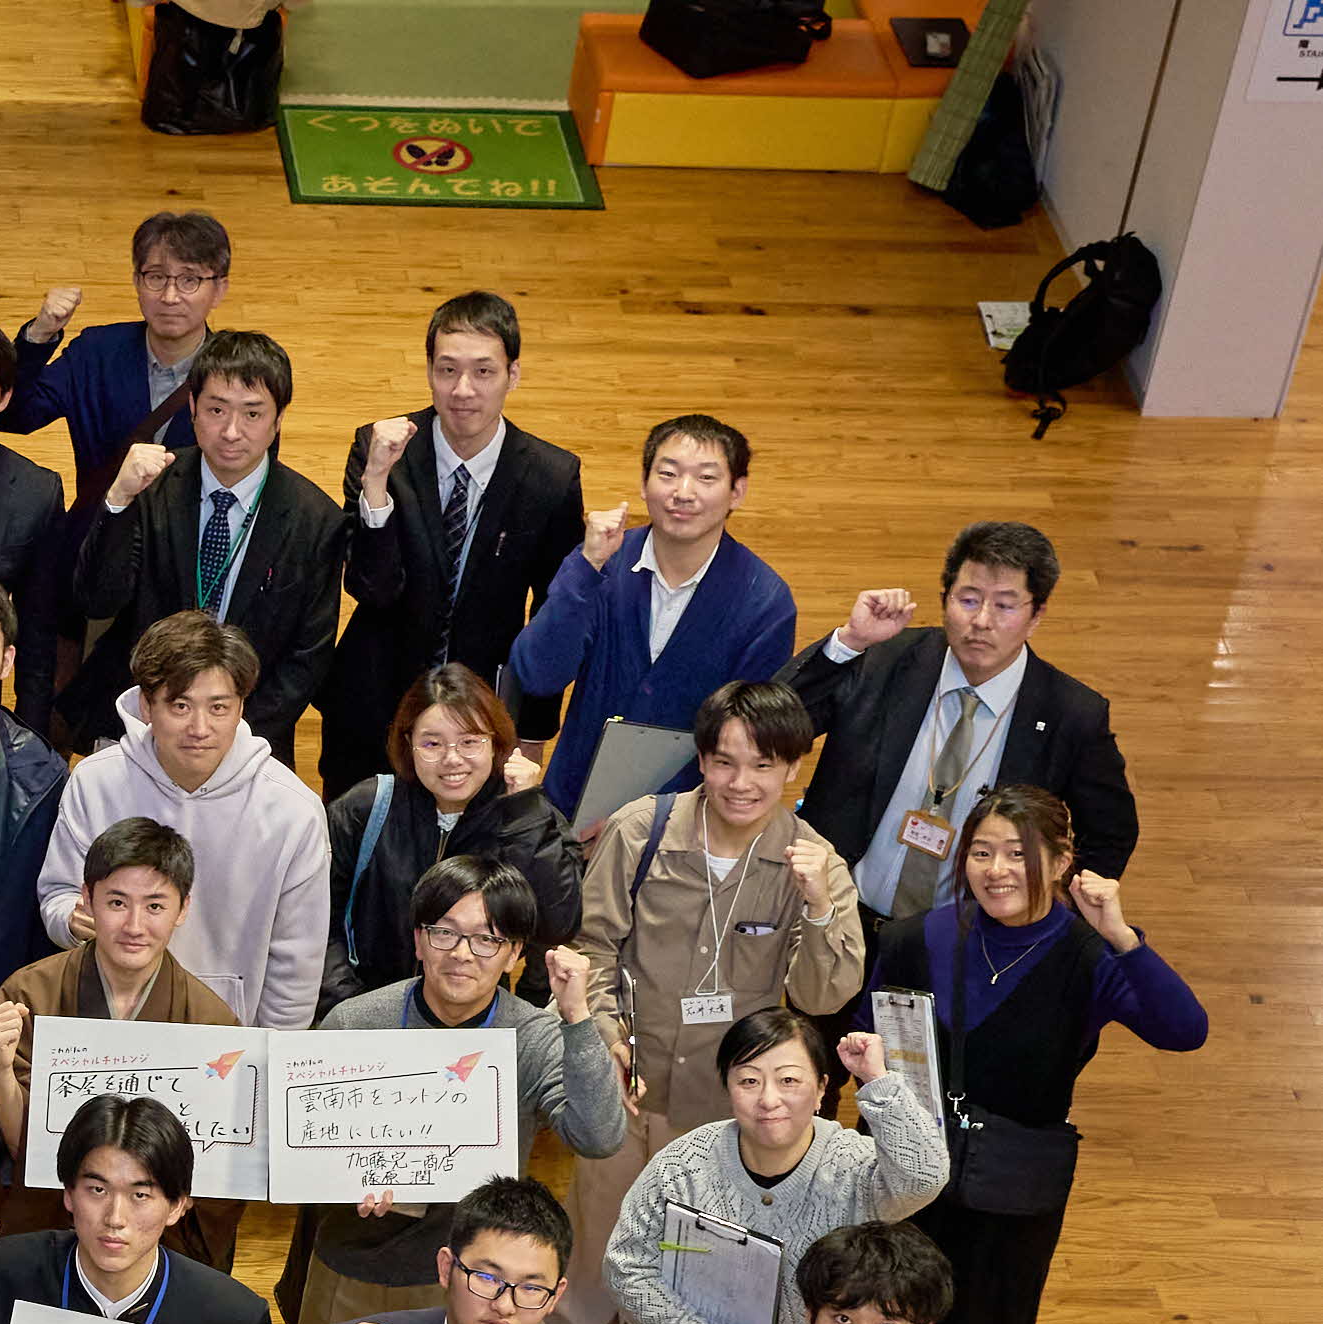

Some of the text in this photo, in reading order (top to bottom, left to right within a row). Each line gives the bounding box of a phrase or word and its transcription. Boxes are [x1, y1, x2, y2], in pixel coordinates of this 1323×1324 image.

[307, 115, 544, 137] くつをぬいで
[321, 173, 559, 197] あそんでね!!
[51, 1054, 151, 1069] スペシャルチャレンジ
[286, 1061, 387, 1082] スペシャルチャレンジ
[53, 1073, 186, 1097] 茶屋を通じて
[298, 1086, 468, 1114] 雲南市をコットンの
